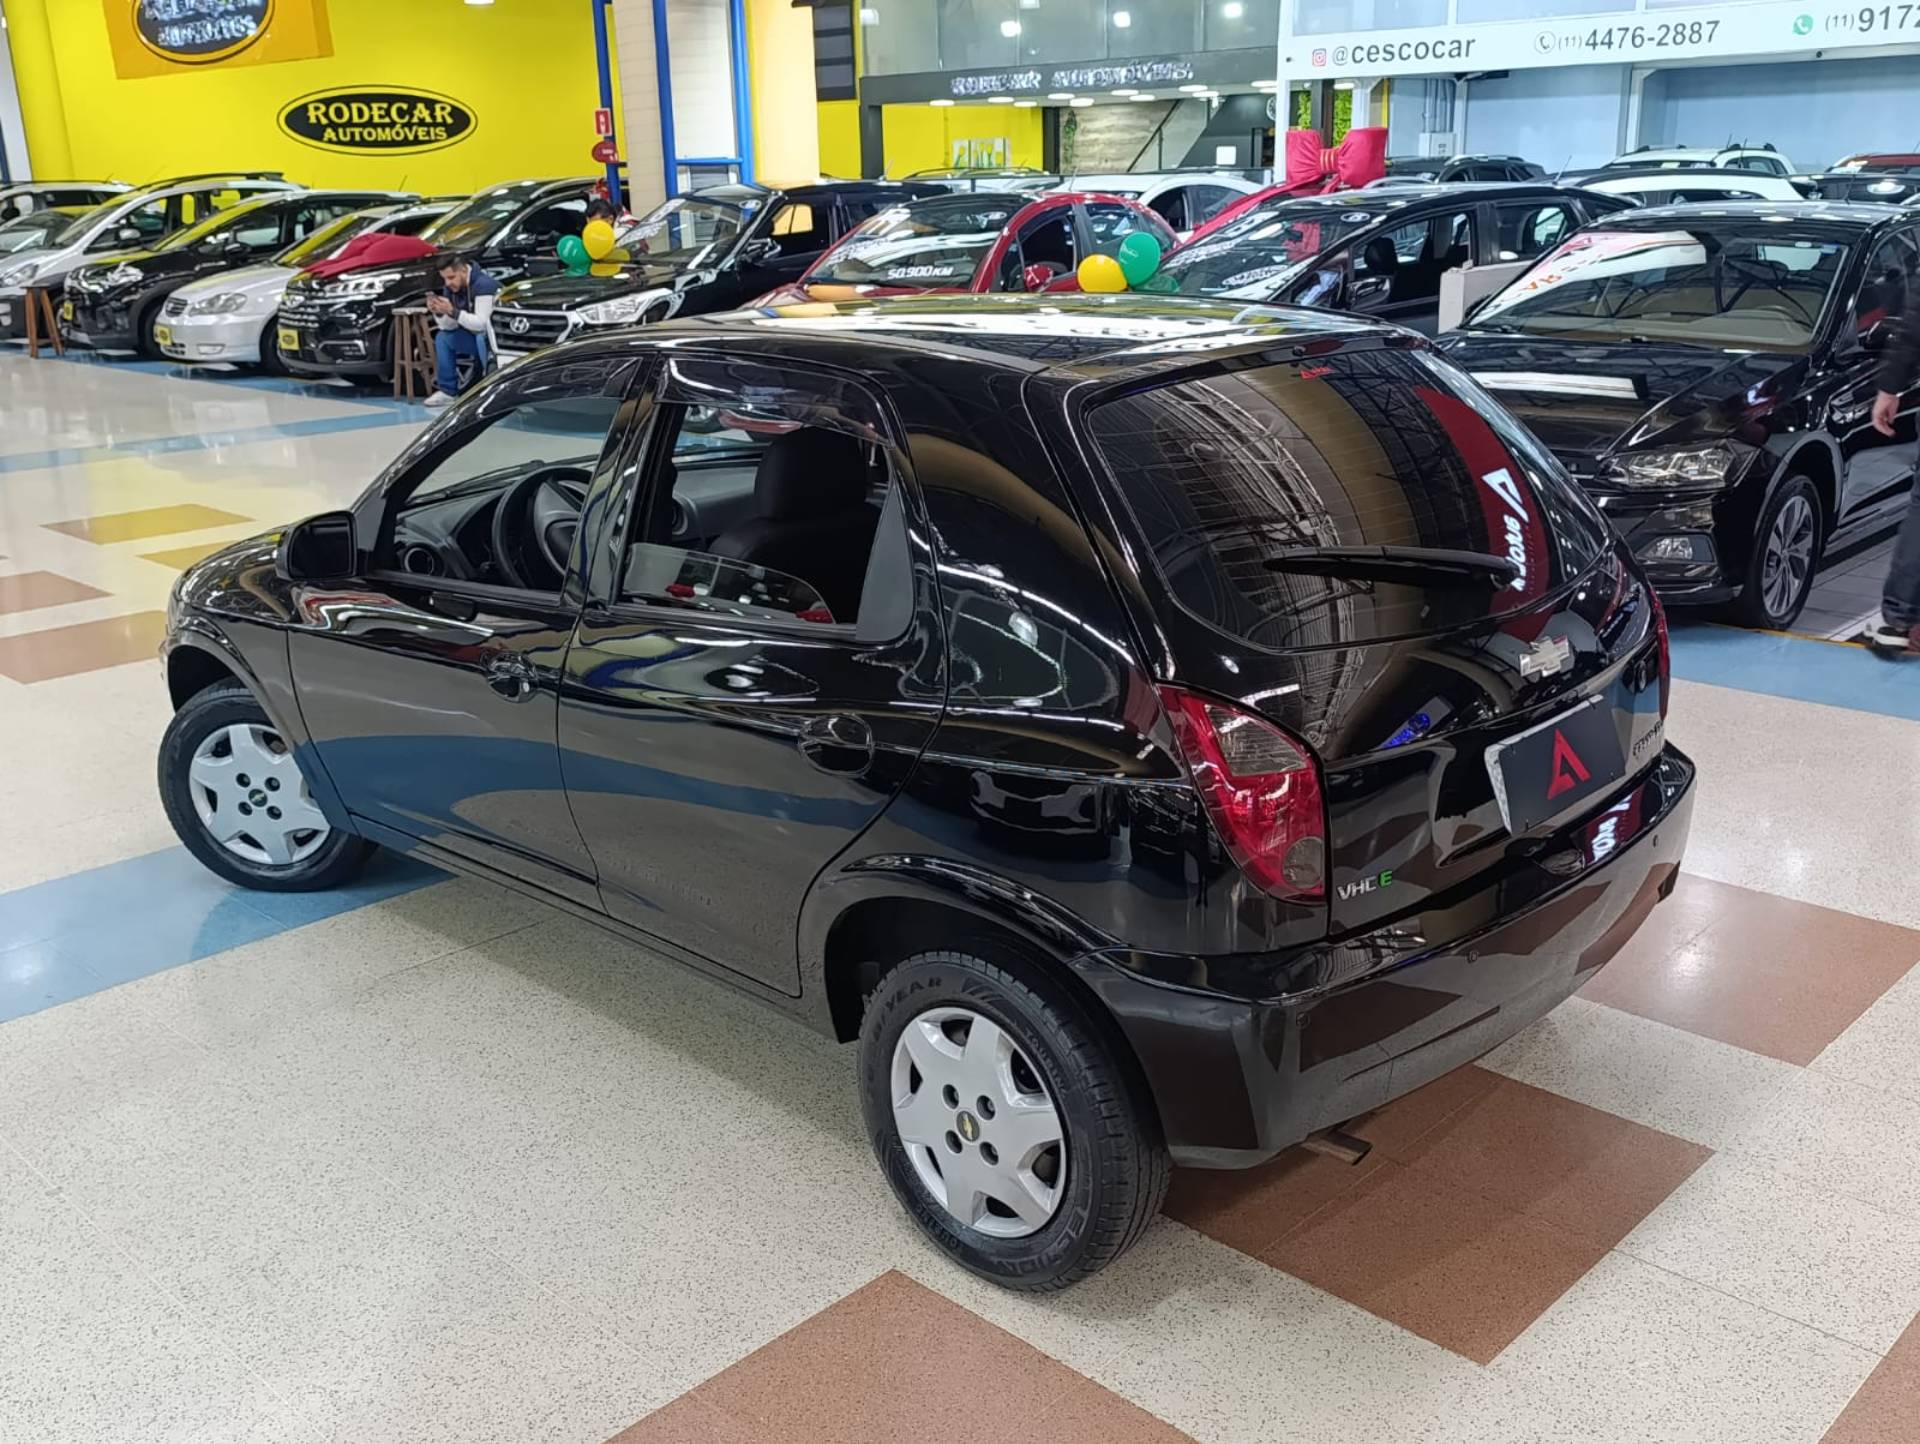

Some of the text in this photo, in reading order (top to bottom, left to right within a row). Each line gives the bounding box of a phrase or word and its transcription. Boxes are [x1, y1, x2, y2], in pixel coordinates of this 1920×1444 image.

[1333, 38, 1476, 66] @cescocar
[307, 102, 454, 125] RODECAR
[323, 124, 448, 142] AUTOMÓVEIS
[1337, 869, 1393, 900] VHCE
